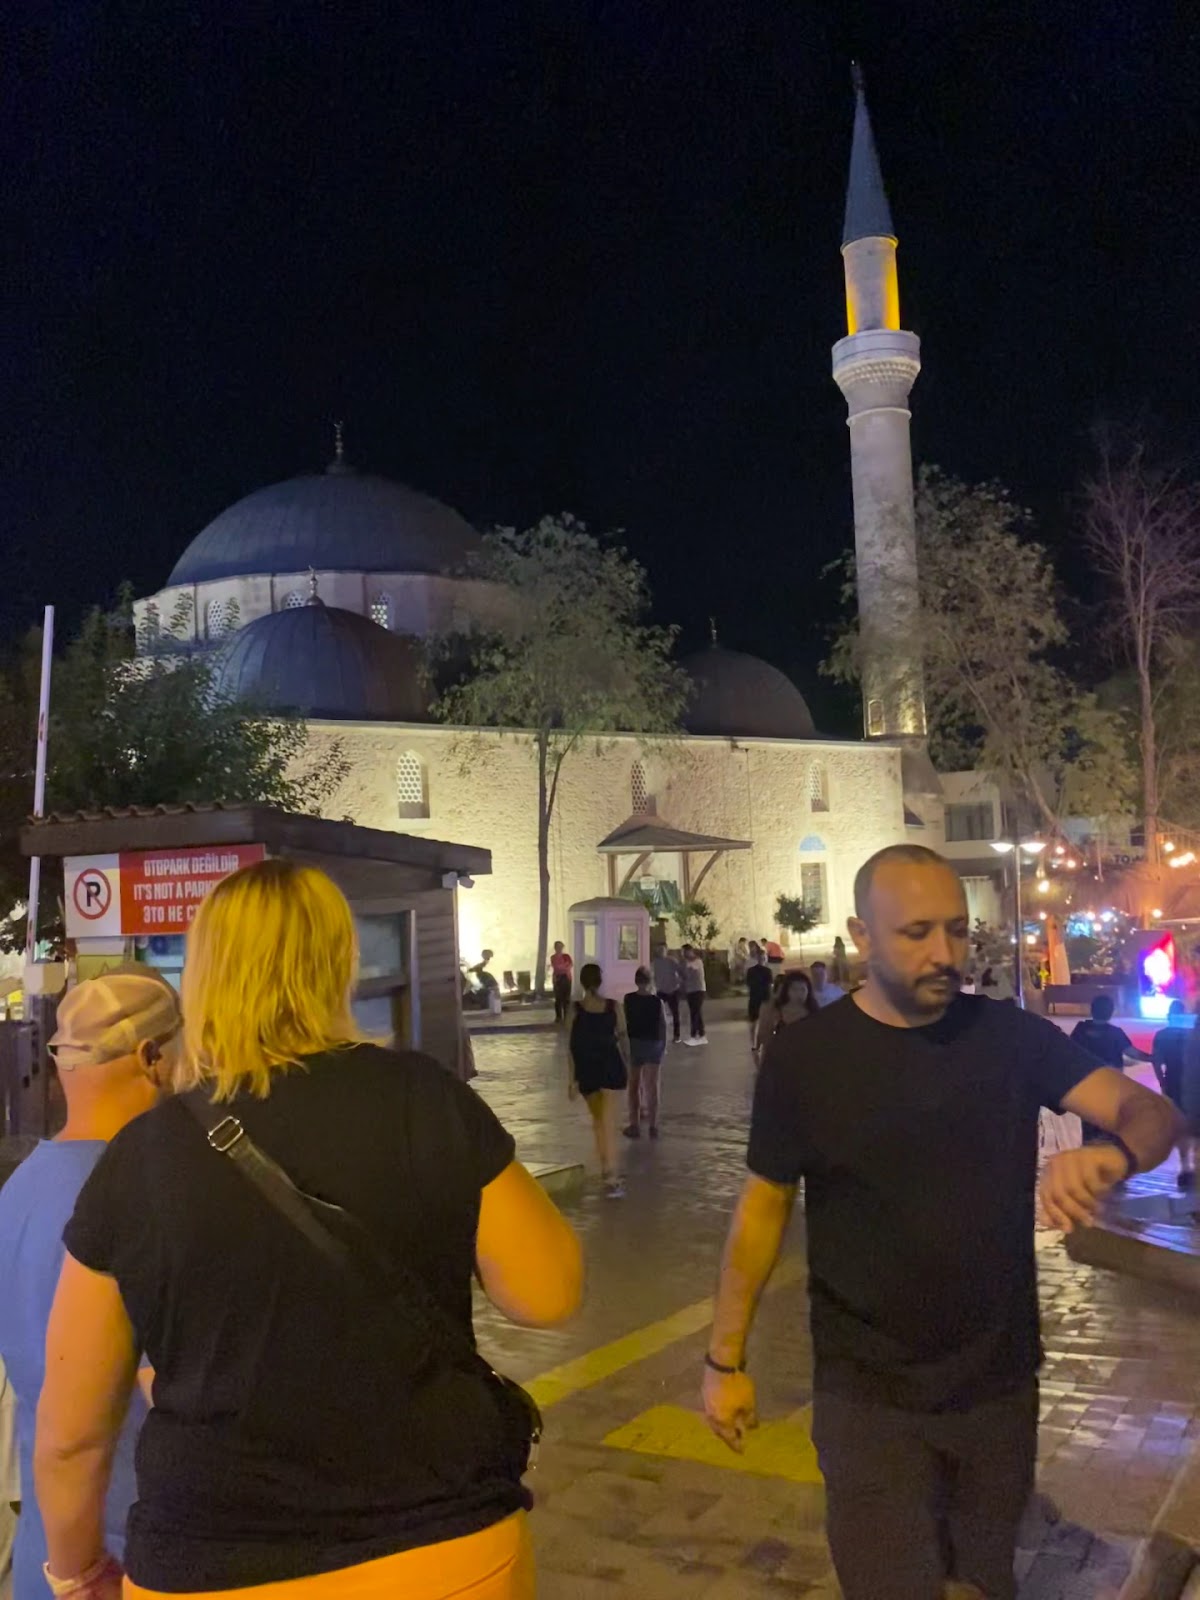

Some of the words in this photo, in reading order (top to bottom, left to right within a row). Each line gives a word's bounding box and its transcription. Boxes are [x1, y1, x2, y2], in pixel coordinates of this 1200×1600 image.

[143, 857, 190, 877] OTOPARK
[133, 883, 152, 901] IT'S
[154, 881, 174, 900] NOT
[176, 881, 183, 898] A
[143, 905, 164, 923] ЭТО
[168, 904, 183, 922] НЕ
